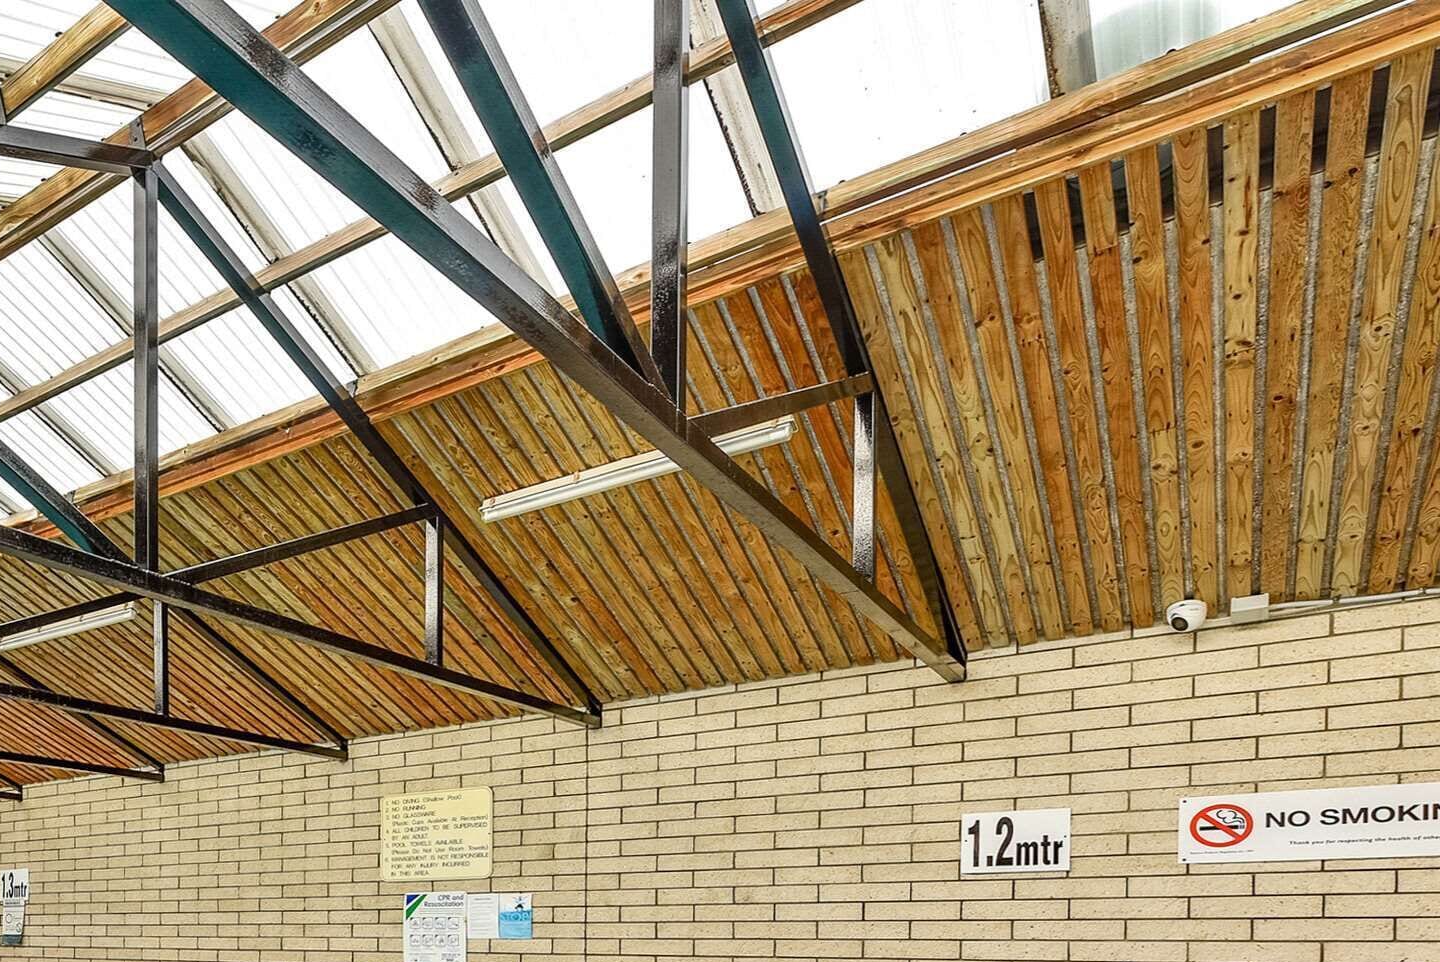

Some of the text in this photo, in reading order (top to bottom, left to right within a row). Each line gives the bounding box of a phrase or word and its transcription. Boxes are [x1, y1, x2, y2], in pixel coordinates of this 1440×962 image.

[1265, 810, 1310, 828] NO
[968, 817, 1063, 867] 1.2mtr
[2, 872, 27, 898] 1.3mtr
